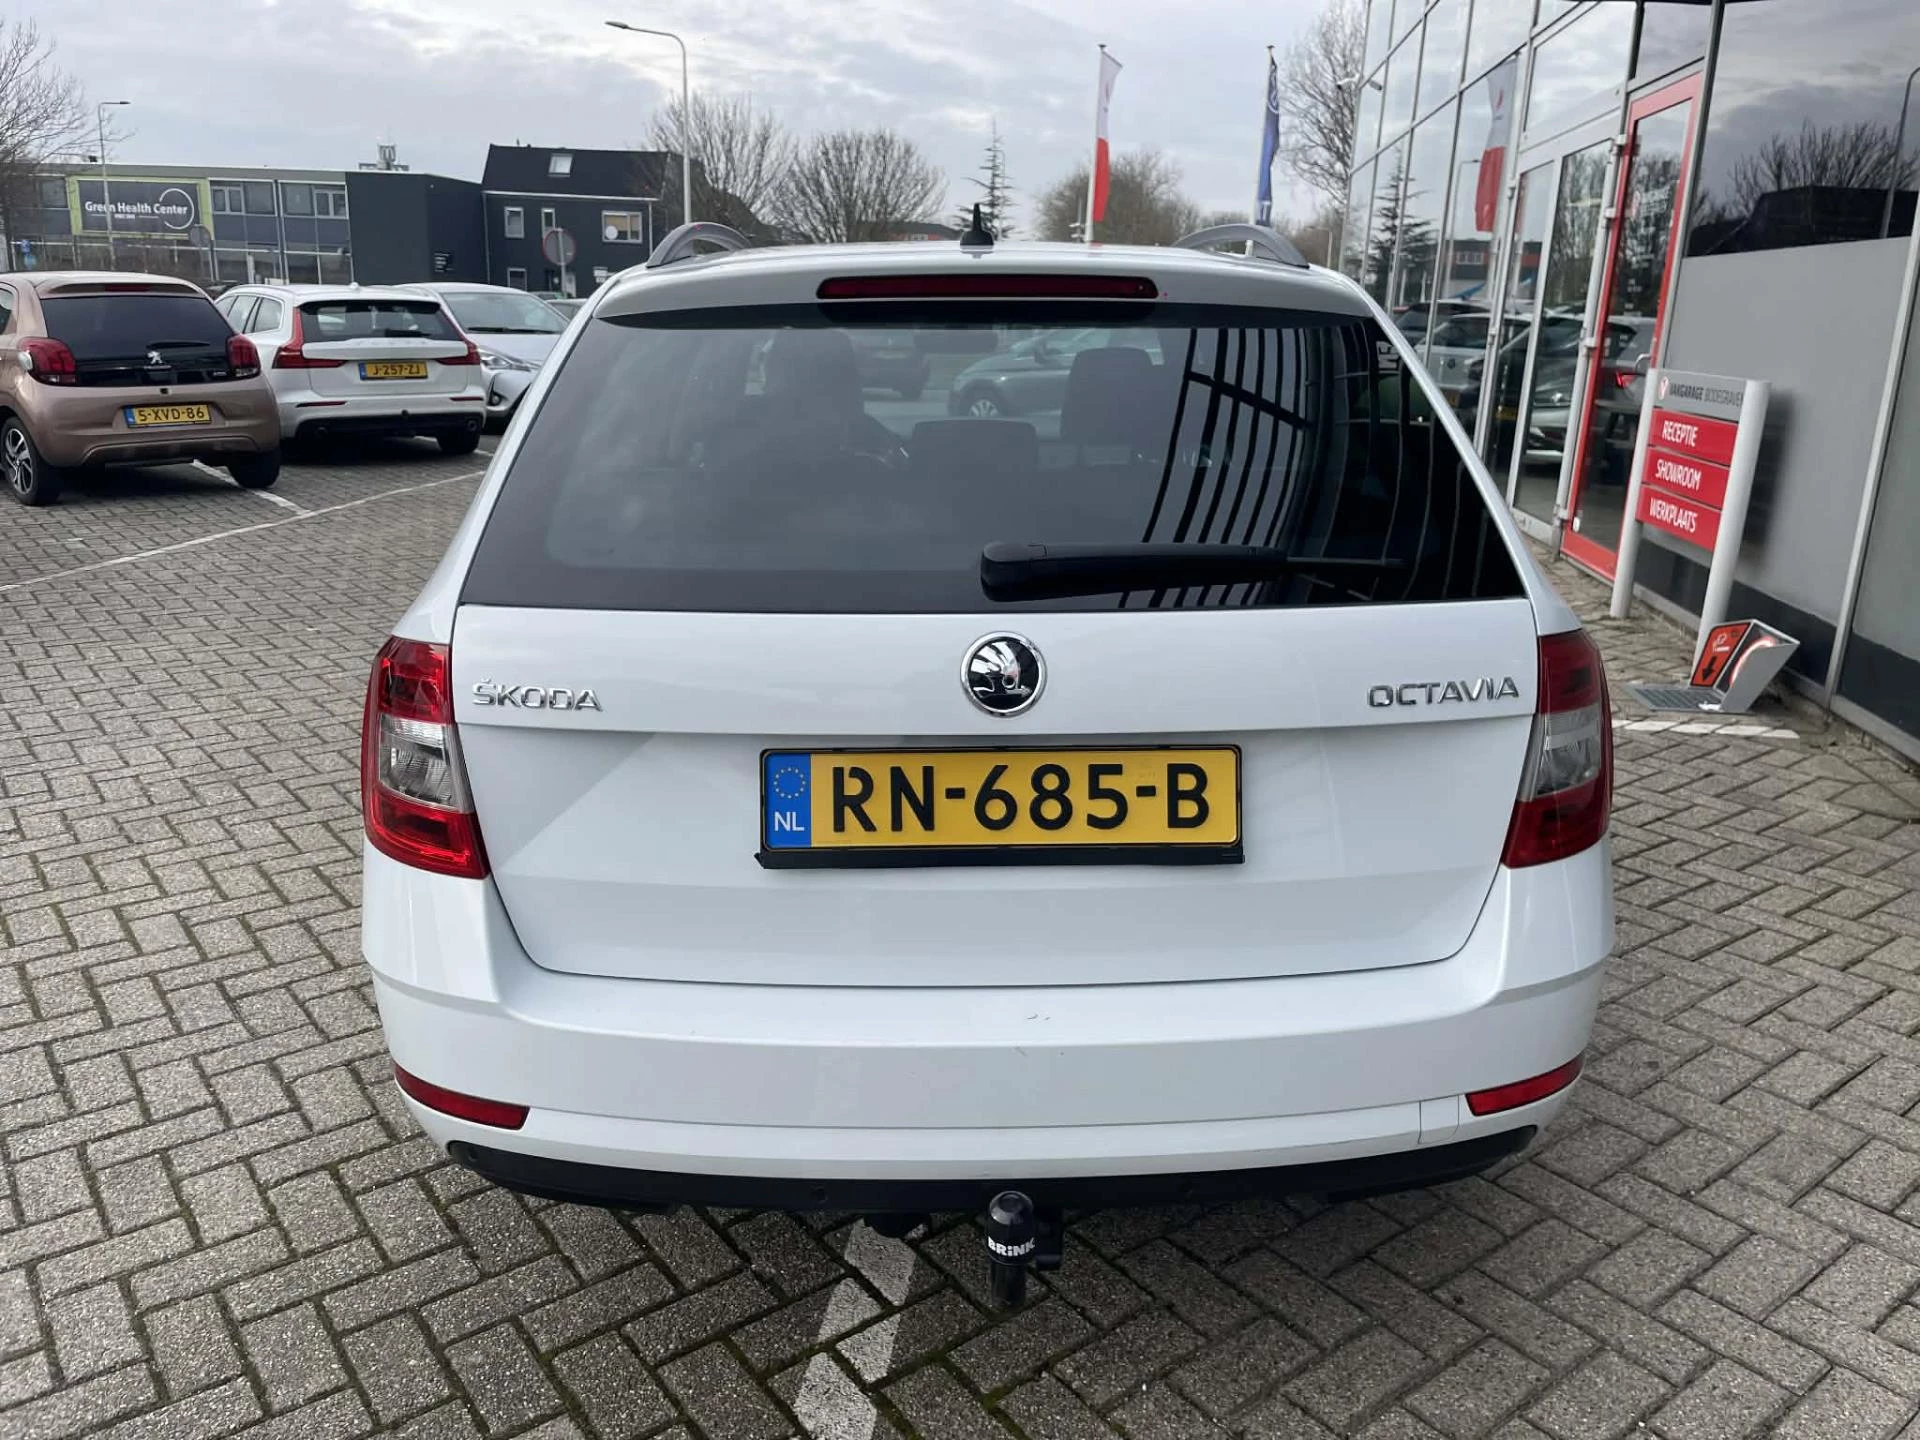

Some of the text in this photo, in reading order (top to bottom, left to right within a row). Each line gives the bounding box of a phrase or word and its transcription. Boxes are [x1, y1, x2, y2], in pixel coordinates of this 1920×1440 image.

[117, 202, 152, 214] Health
[153, 203, 188, 215] Center
[138, 407, 205, 422] 5-XVD-86
[1662, 420, 1699, 447] RECEPTIE
[1655, 459, 1702, 491] SHOWROOM
[1650, 498, 1698, 534] WERKPLAATS
[472, 677, 603, 712] ŠKODA
[1367, 676, 1520, 708] OCTAVIA
[832, 762, 1210, 833] RN-685-B
[773, 811, 805, 832] NL
